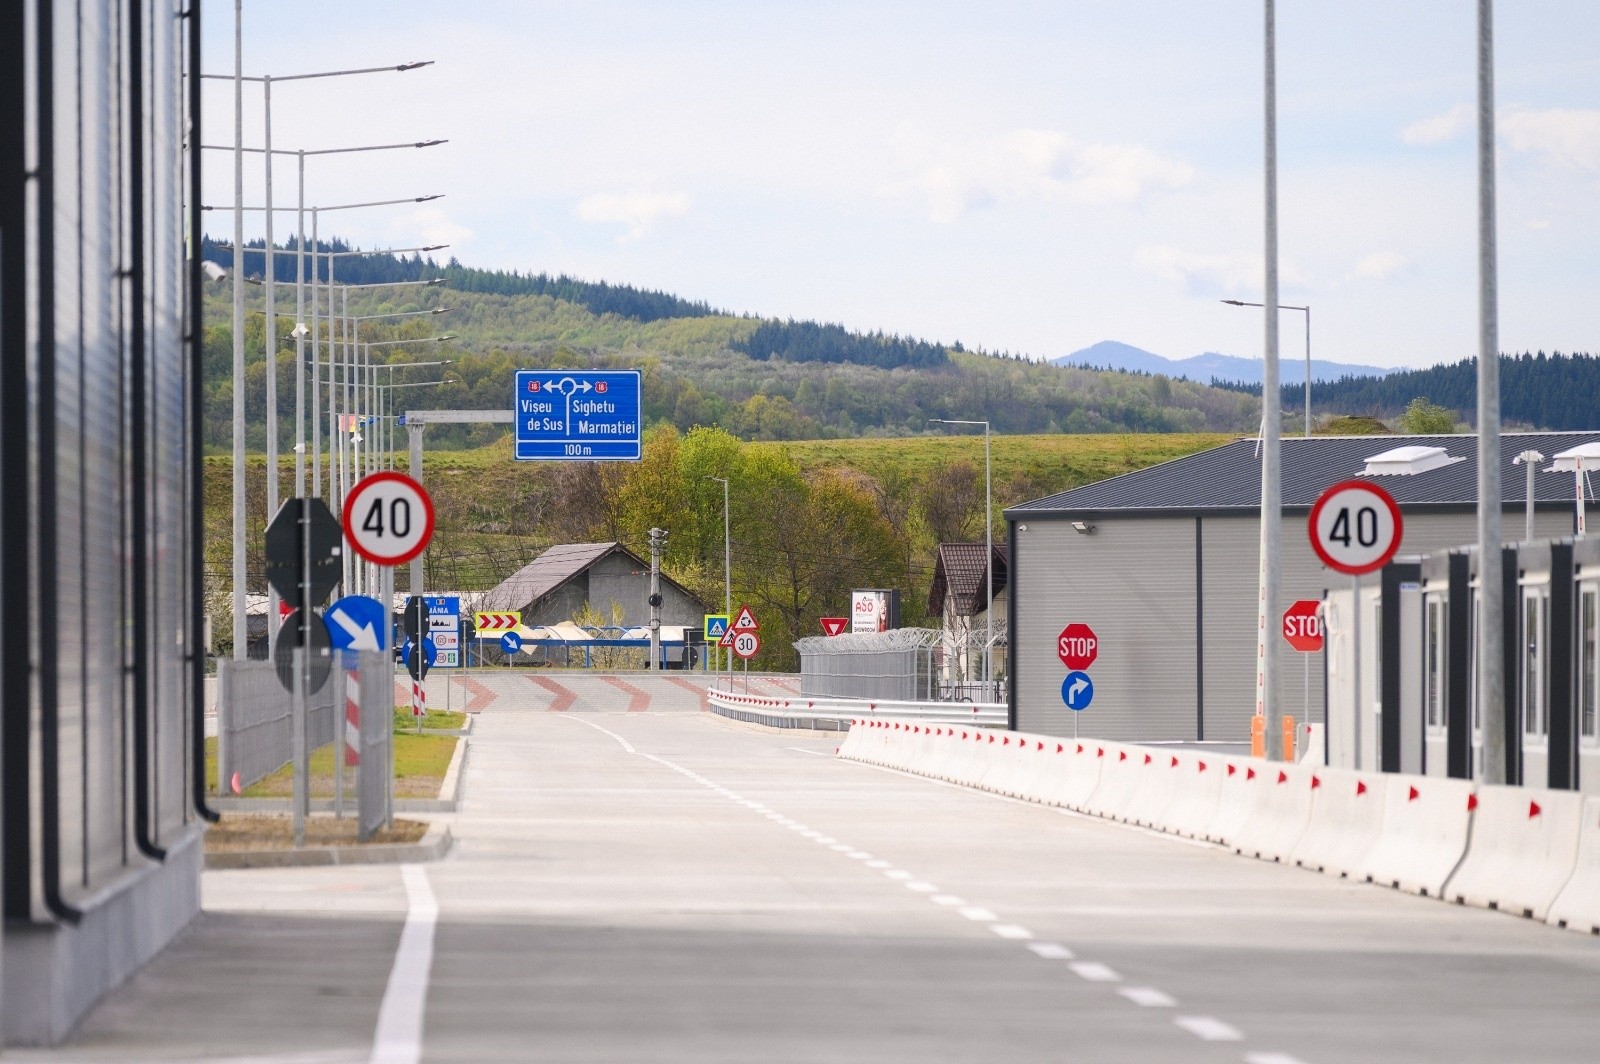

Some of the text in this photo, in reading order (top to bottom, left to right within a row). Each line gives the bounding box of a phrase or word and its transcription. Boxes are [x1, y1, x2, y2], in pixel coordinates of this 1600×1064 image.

[521, 399, 552, 414] Vișeu
[572, 400, 615, 416] Sighetu
[527, 417, 563, 431] de Sus
[578, 420, 636, 435] Marmației
[564, 444, 592, 456] 100 m
[362, 497, 410, 538] 40
[1329, 506, 1378, 548] 40
[738, 637, 753, 651] 30
[1060, 637, 1096, 657] STOP
